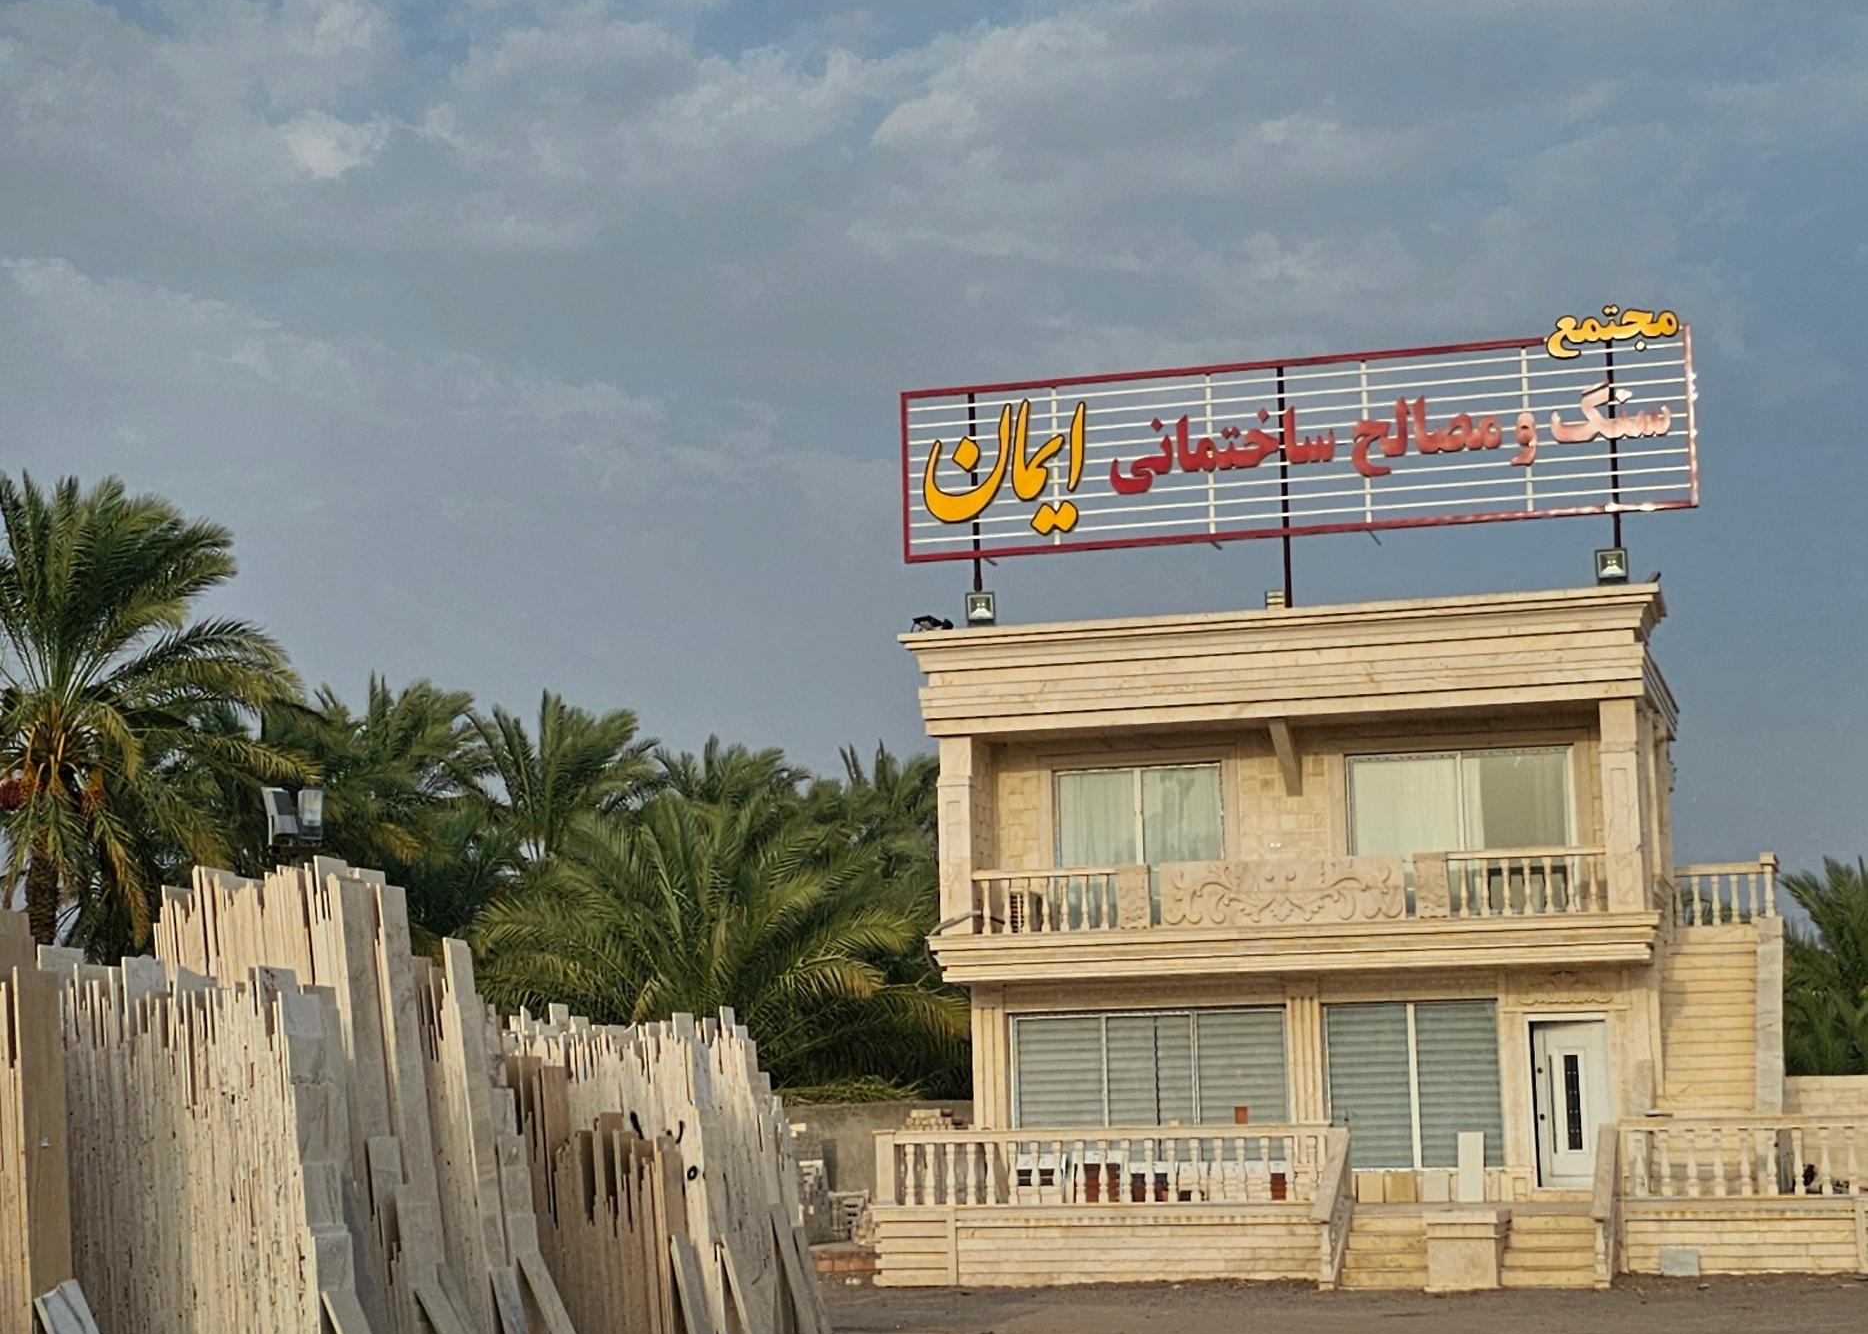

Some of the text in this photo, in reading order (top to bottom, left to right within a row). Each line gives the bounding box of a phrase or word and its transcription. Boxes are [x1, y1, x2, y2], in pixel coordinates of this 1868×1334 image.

[1547, 304, 1679, 359] مجتمع
[923, 398, 1086, 536] ایمان
[1109, 405, 1335, 495] ساختمانی
[1351, 394, 1502, 477] مصالح
[1510, 410, 1538, 466] و
